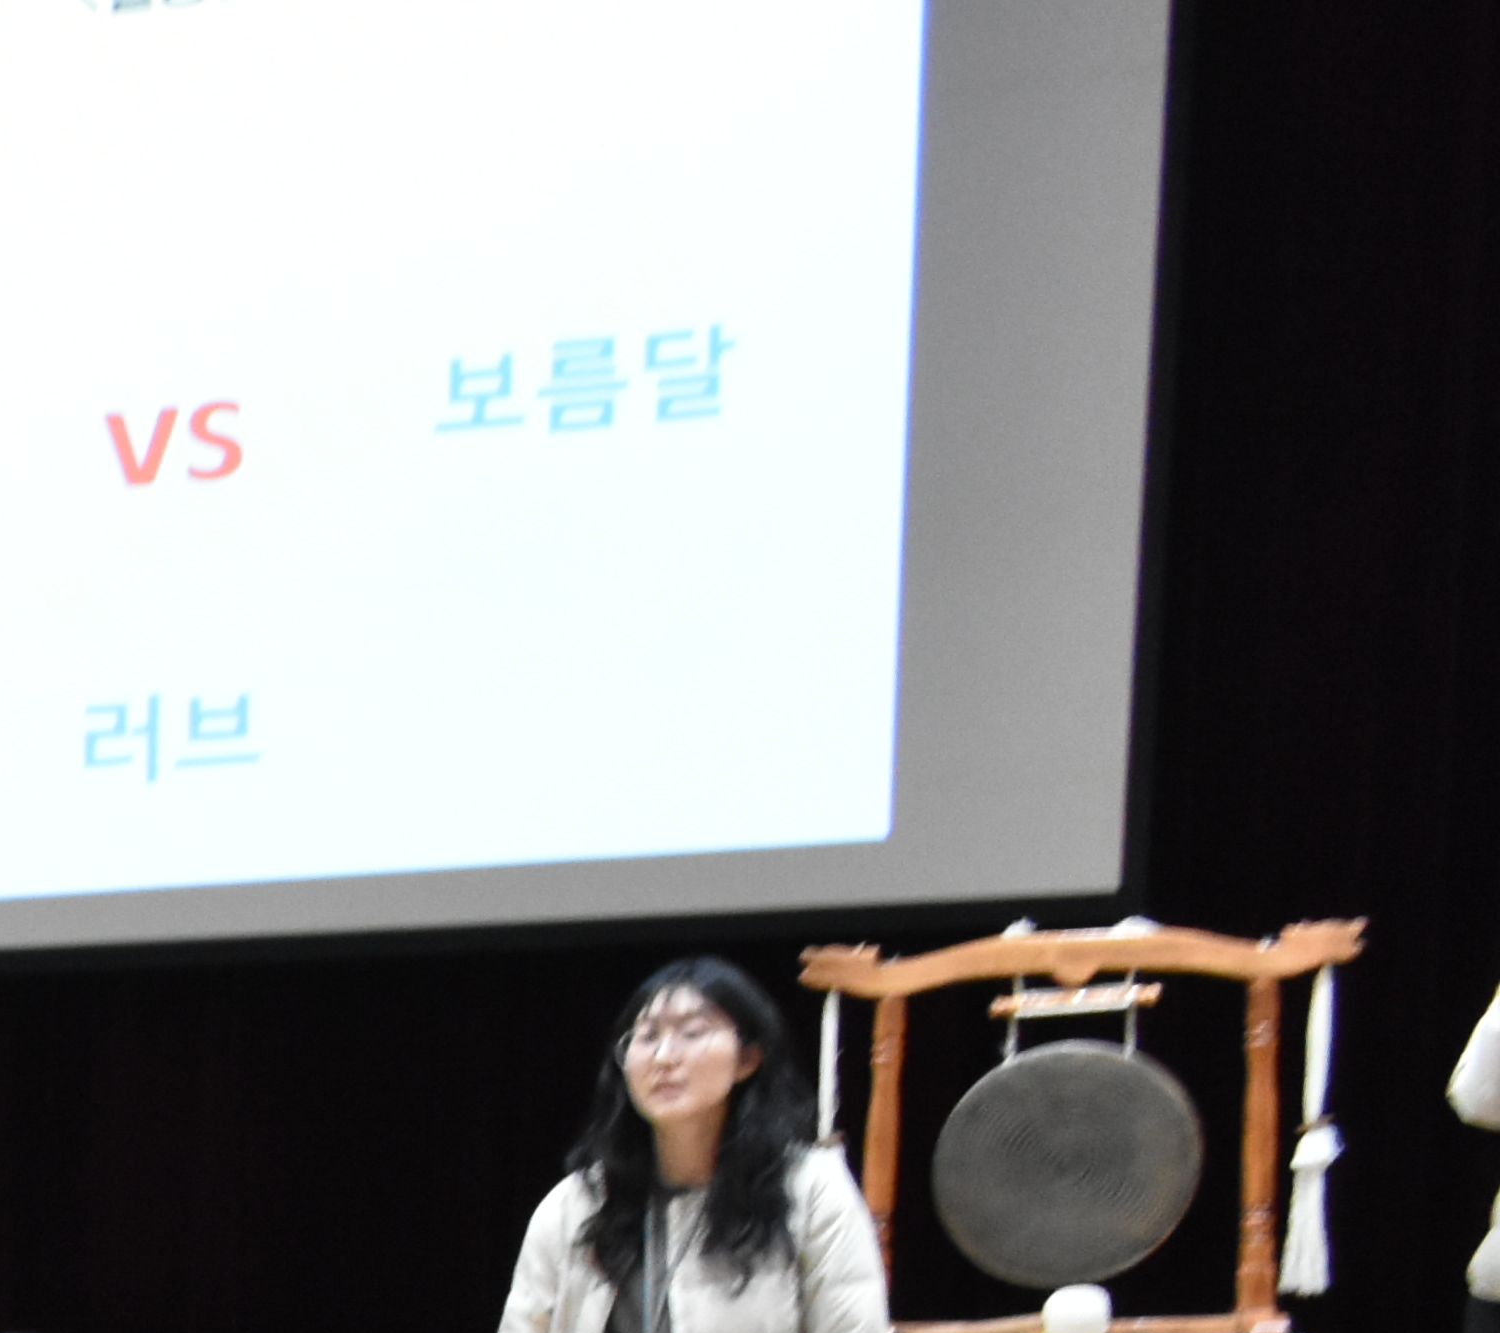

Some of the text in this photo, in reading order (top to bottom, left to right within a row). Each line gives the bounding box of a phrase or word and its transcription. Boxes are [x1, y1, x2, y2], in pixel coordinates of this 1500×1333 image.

[434, 322, 737, 434] 보름달
[107, 402, 244, 487] VS
[83, 692, 261, 784] 러브
